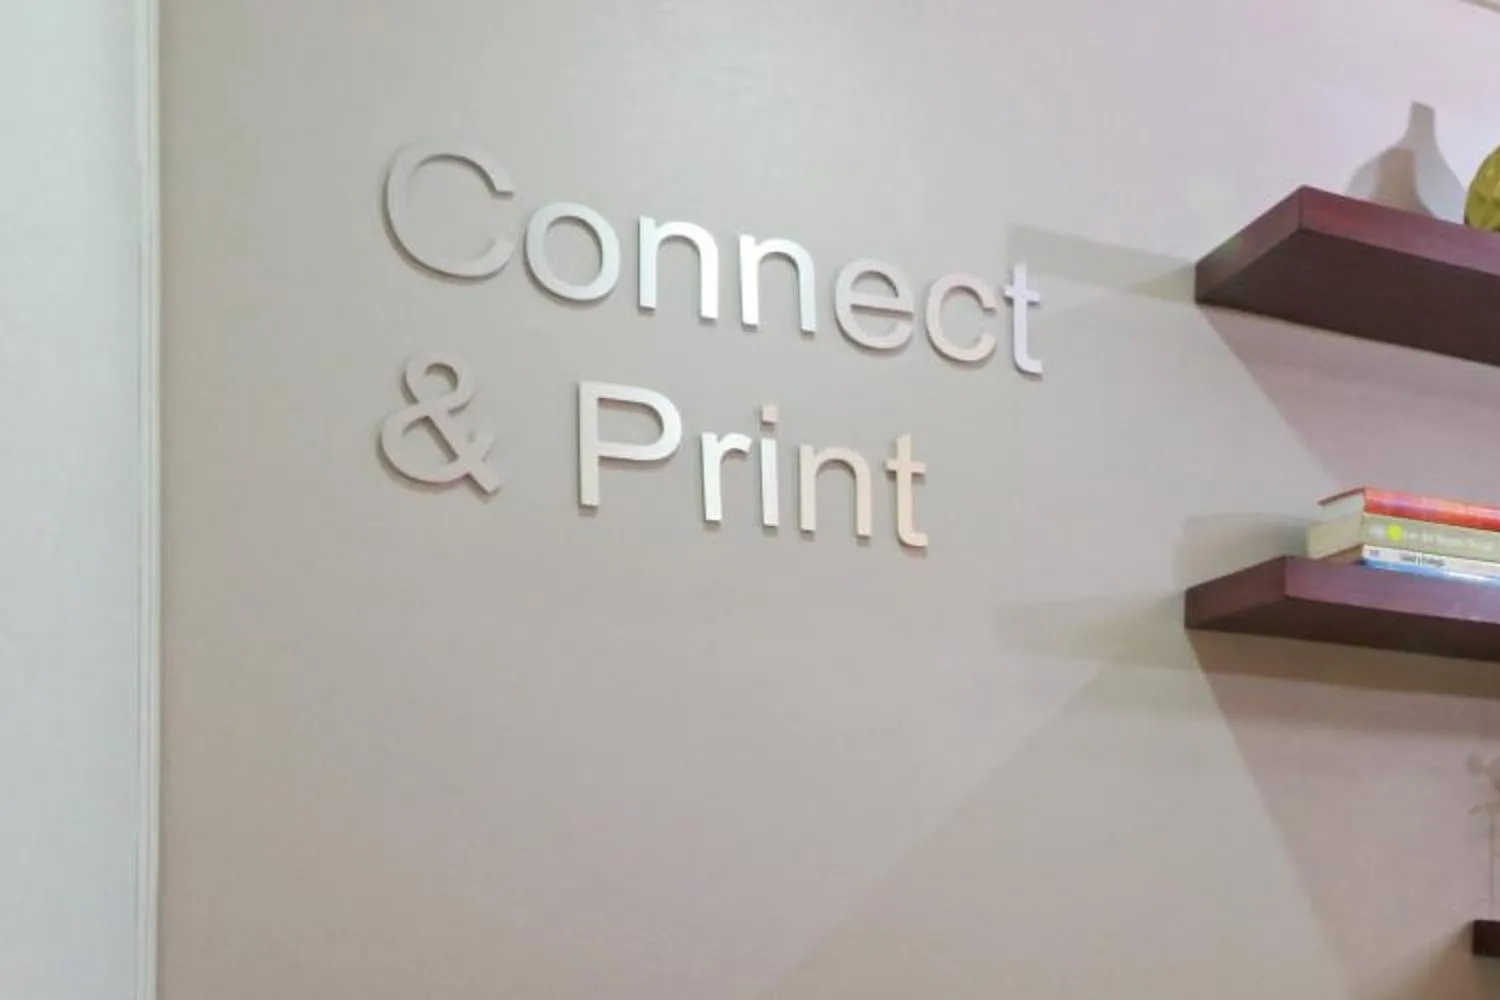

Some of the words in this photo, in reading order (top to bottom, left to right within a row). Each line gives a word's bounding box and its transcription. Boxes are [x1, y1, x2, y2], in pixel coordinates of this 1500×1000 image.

[382, 142, 1043, 376] Connect
[379, 352, 501, 494] &
[578, 381, 929, 548] Print
